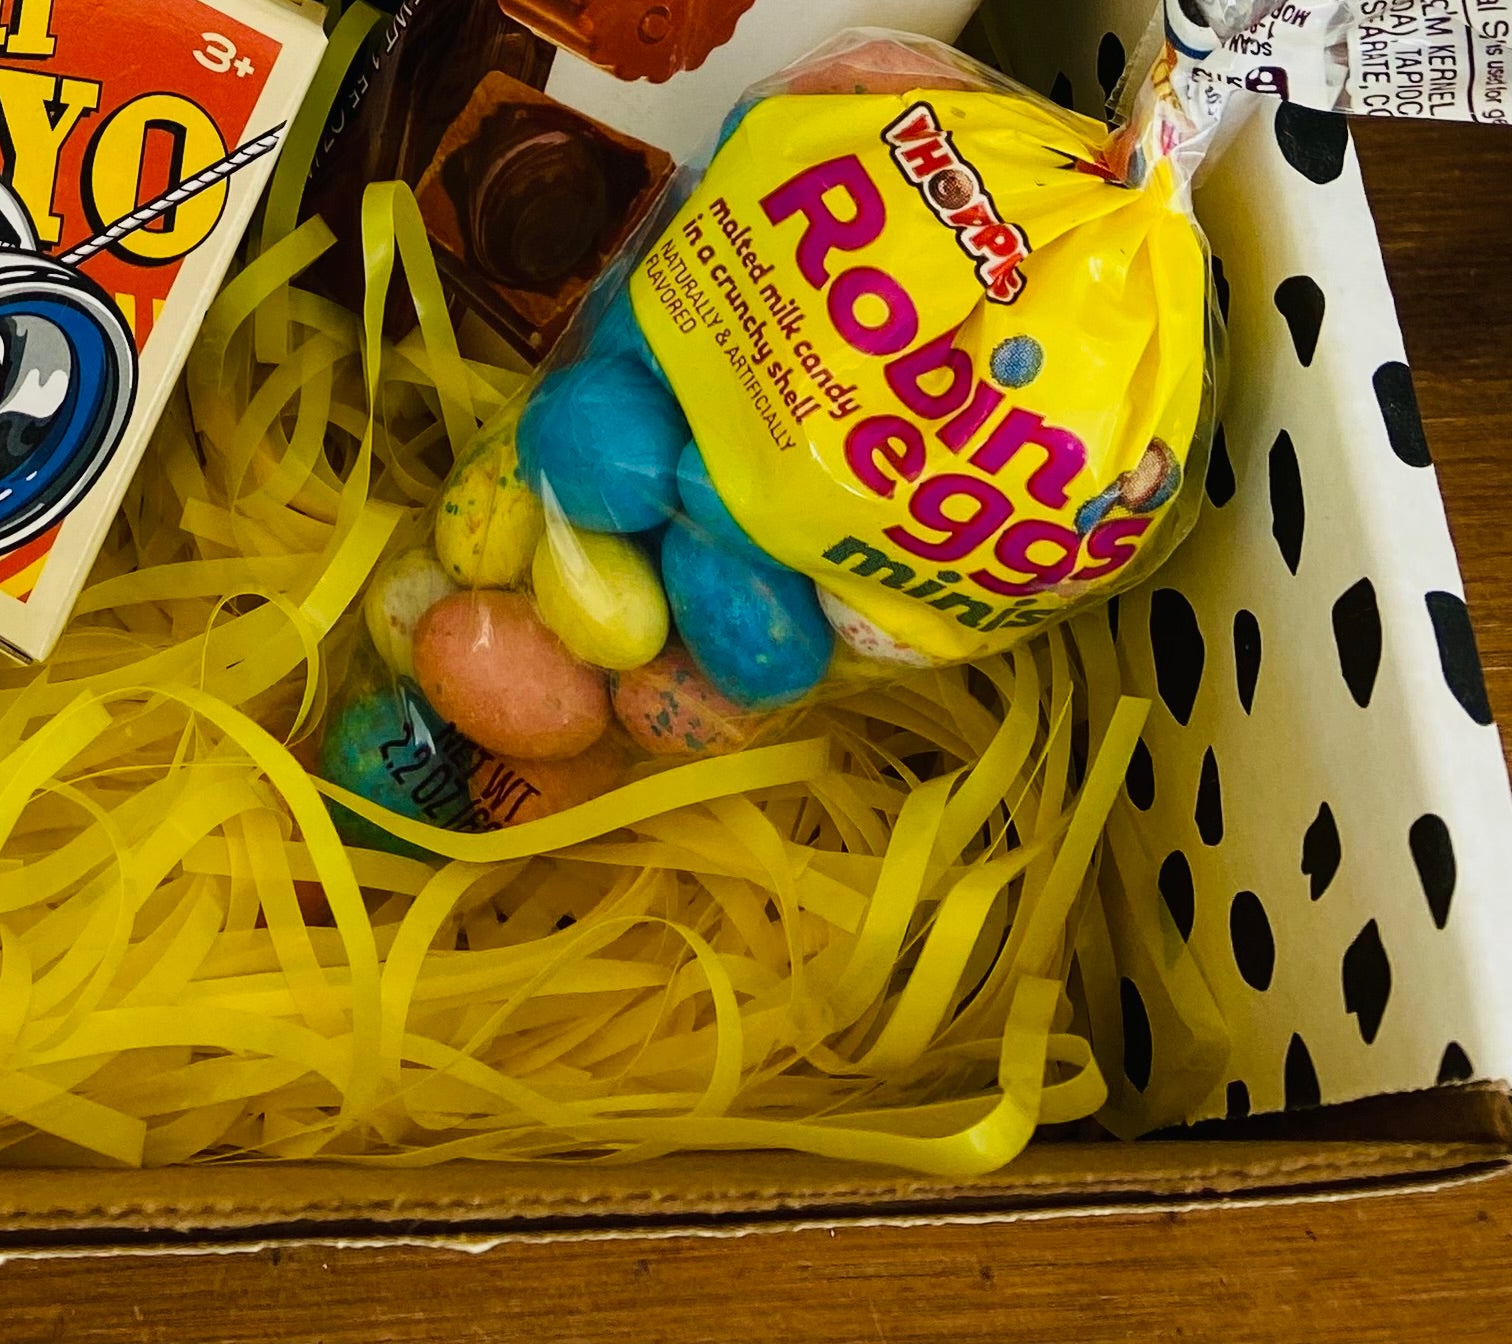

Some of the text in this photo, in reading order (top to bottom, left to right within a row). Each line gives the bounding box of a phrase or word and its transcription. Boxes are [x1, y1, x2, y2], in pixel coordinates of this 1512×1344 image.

[191, 29, 258, 81] 3+
[1395, 48, 1424, 115] TAPIOC
[645, 253, 698, 335] FLAVORED
[660, 238, 797, 452] NATURALLY & ARTIFICIALLY
[682, 213, 821, 425] in a crunchy shell
[708, 197, 863, 420] malted milk candy
[759, 154, 1089, 510] Robin
[844, 414, 1156, 598] eggs
[481, 762, 541, 822] WT
